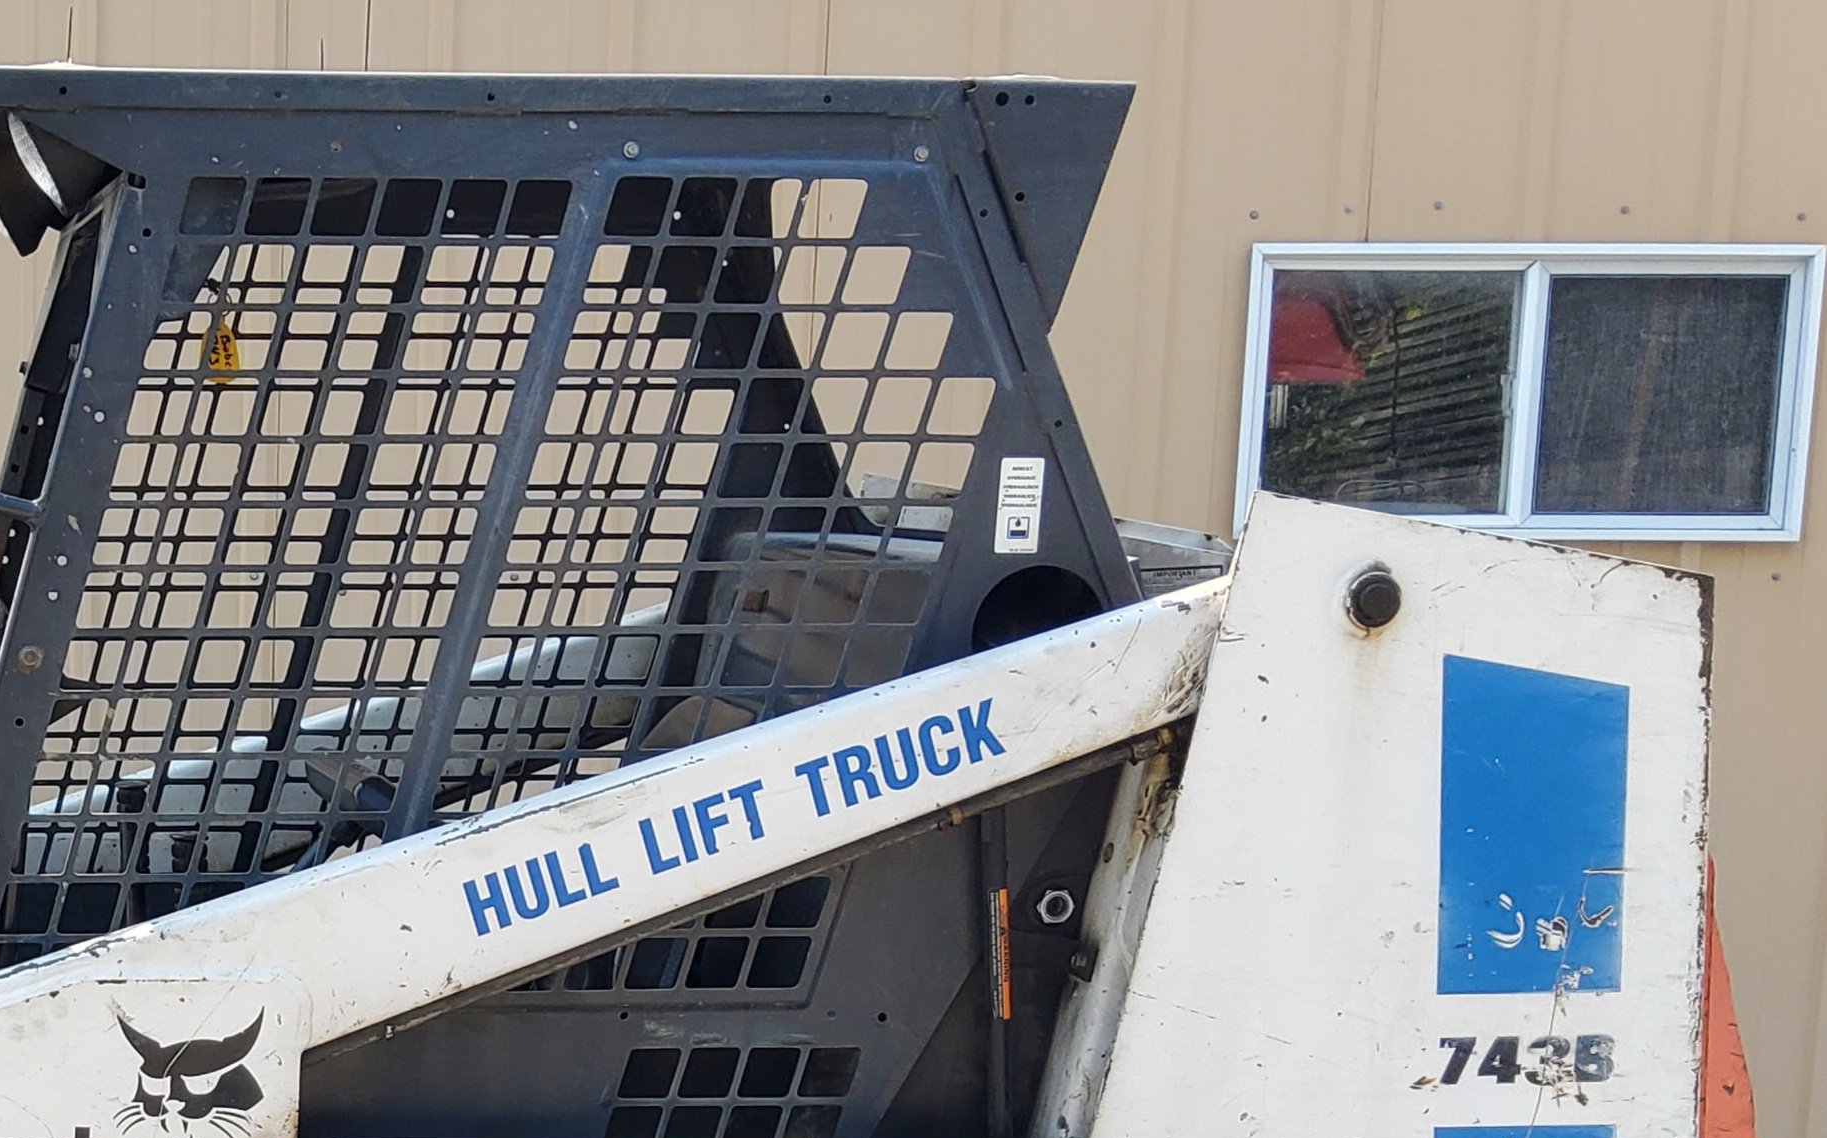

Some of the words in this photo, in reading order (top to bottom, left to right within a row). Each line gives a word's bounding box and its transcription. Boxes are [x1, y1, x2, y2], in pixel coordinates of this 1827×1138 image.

[463, 842, 620, 936] HULL
[639, 779, 764, 874] LIFT
[795, 698, 1006, 817] TRUCK
[1439, 1034, 1616, 1086] 743B
